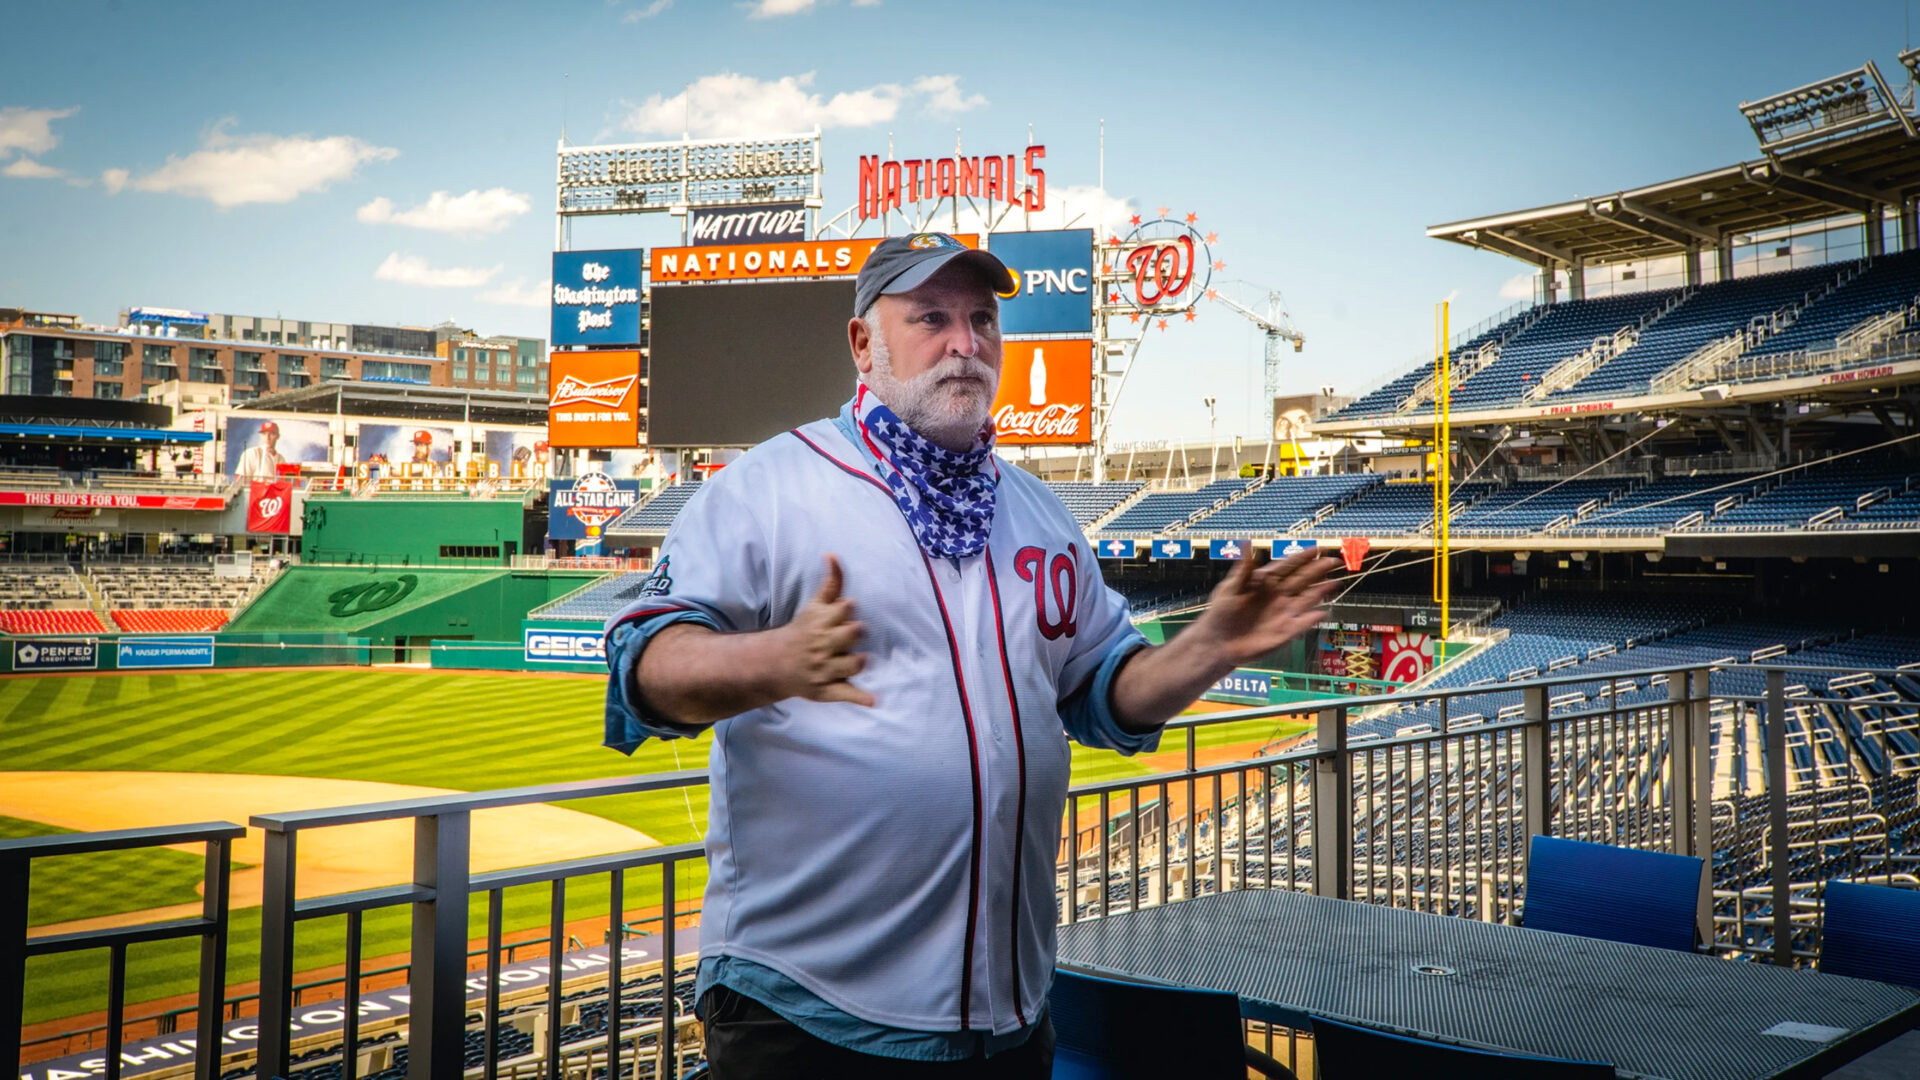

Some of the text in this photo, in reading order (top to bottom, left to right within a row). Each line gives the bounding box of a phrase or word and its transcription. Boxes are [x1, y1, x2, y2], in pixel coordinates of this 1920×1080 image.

[858, 145, 1046, 220] NATIONALS
[692, 209, 806, 240] NATITUDE
[661, 247, 852, 274] NATIONALS
[582, 262, 610, 283] The
[1024, 268, 1087, 294] PNC
[554, 284, 638, 307] Washington
[578, 309, 612, 333] Post
[1831, 366, 1894, 384] FRANK HOWARD
[556, 382, 627, 398] Budweiser
[555, 412, 631, 422] THIS BUD'S FOR YOU.
[1551, 402, 1613, 415] FRANK ROBINSON
[994, 403, 1085, 437] Coca-Cola
[25, 493, 140, 506] THIS BUD'S FOR YOU.
[259, 496, 282, 518] W
[605, 492, 636, 508] GAME
[328, 574, 418, 617] W
[1014, 542, 1077, 641] W
[1411, 612, 1427, 626] rts
[41, 646, 92, 656] PENFED
[135, 649, 160, 657] KAISER
[1224, 677, 1268, 693] DELTA
